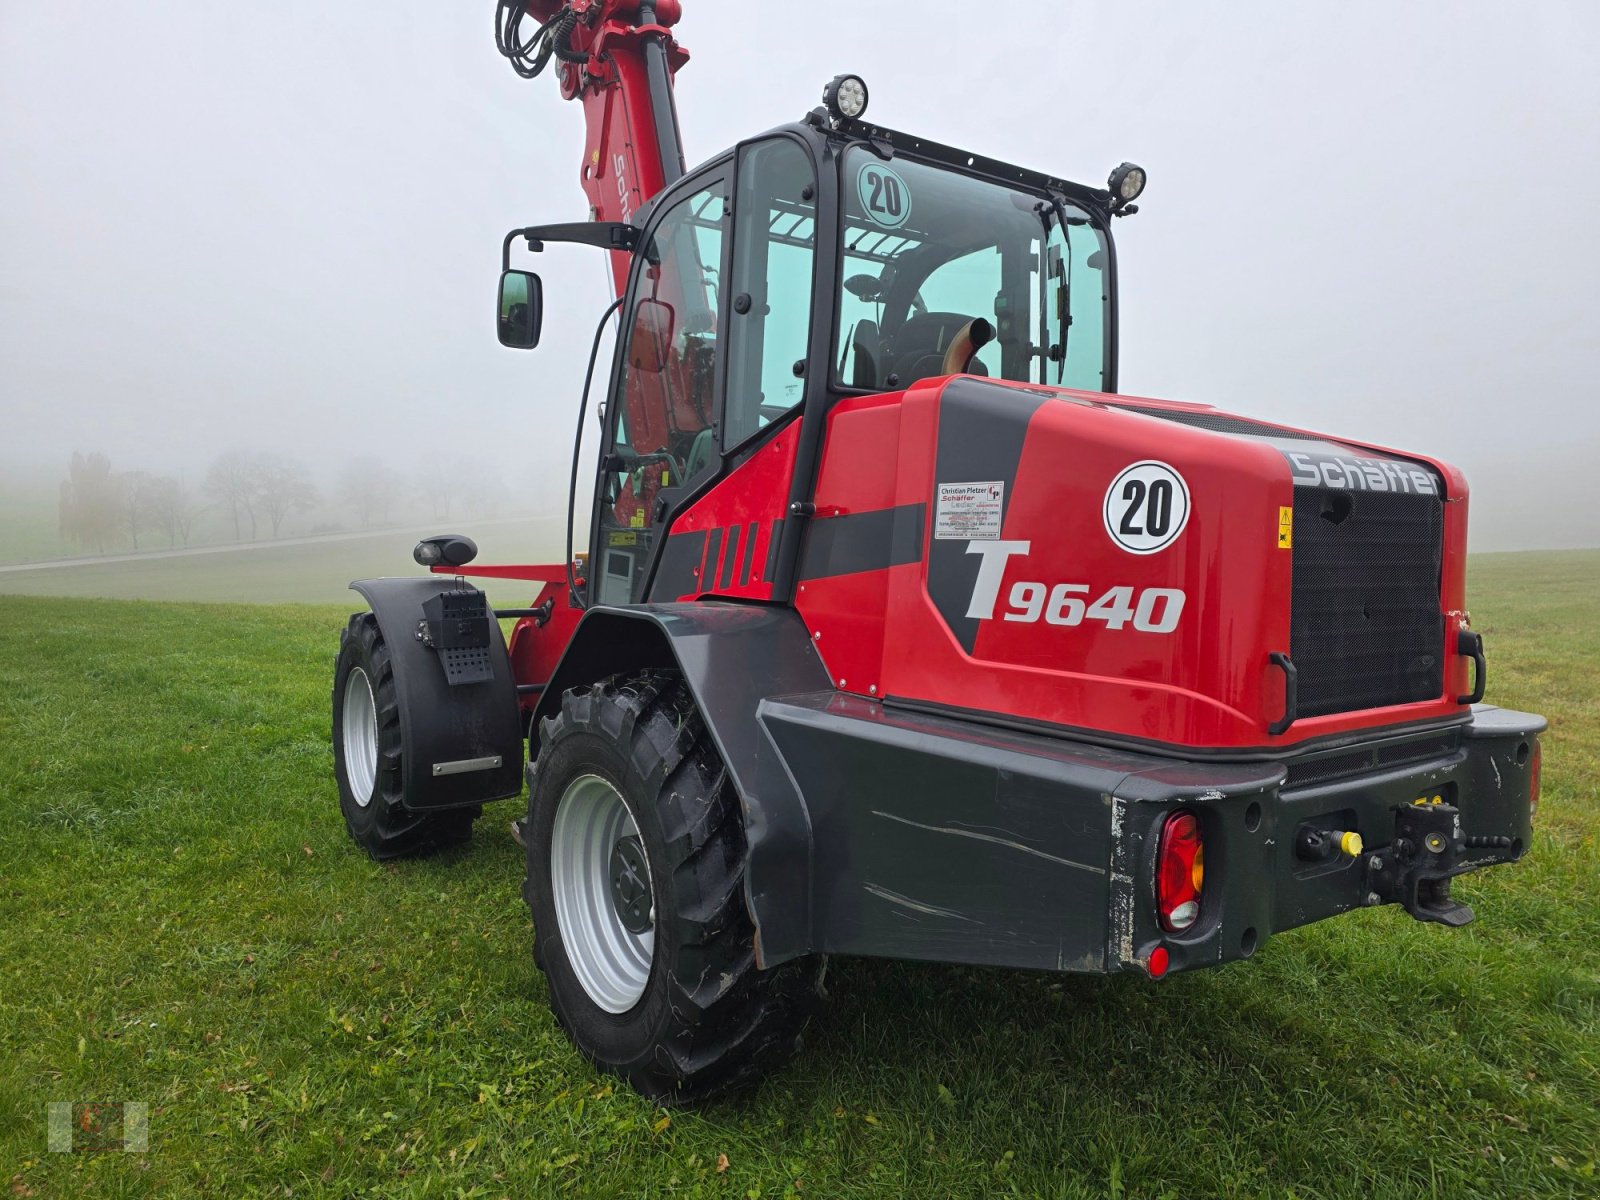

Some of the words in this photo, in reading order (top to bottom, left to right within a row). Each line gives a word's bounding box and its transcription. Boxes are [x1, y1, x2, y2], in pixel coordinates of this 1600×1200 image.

[867, 171, 901, 217] 20
[941, 487, 966, 495] Christian
[966, 486, 987, 494] Pletzer
[1288, 452, 1441, 496] Schäffer
[1119, 479, 1173, 537] 20
